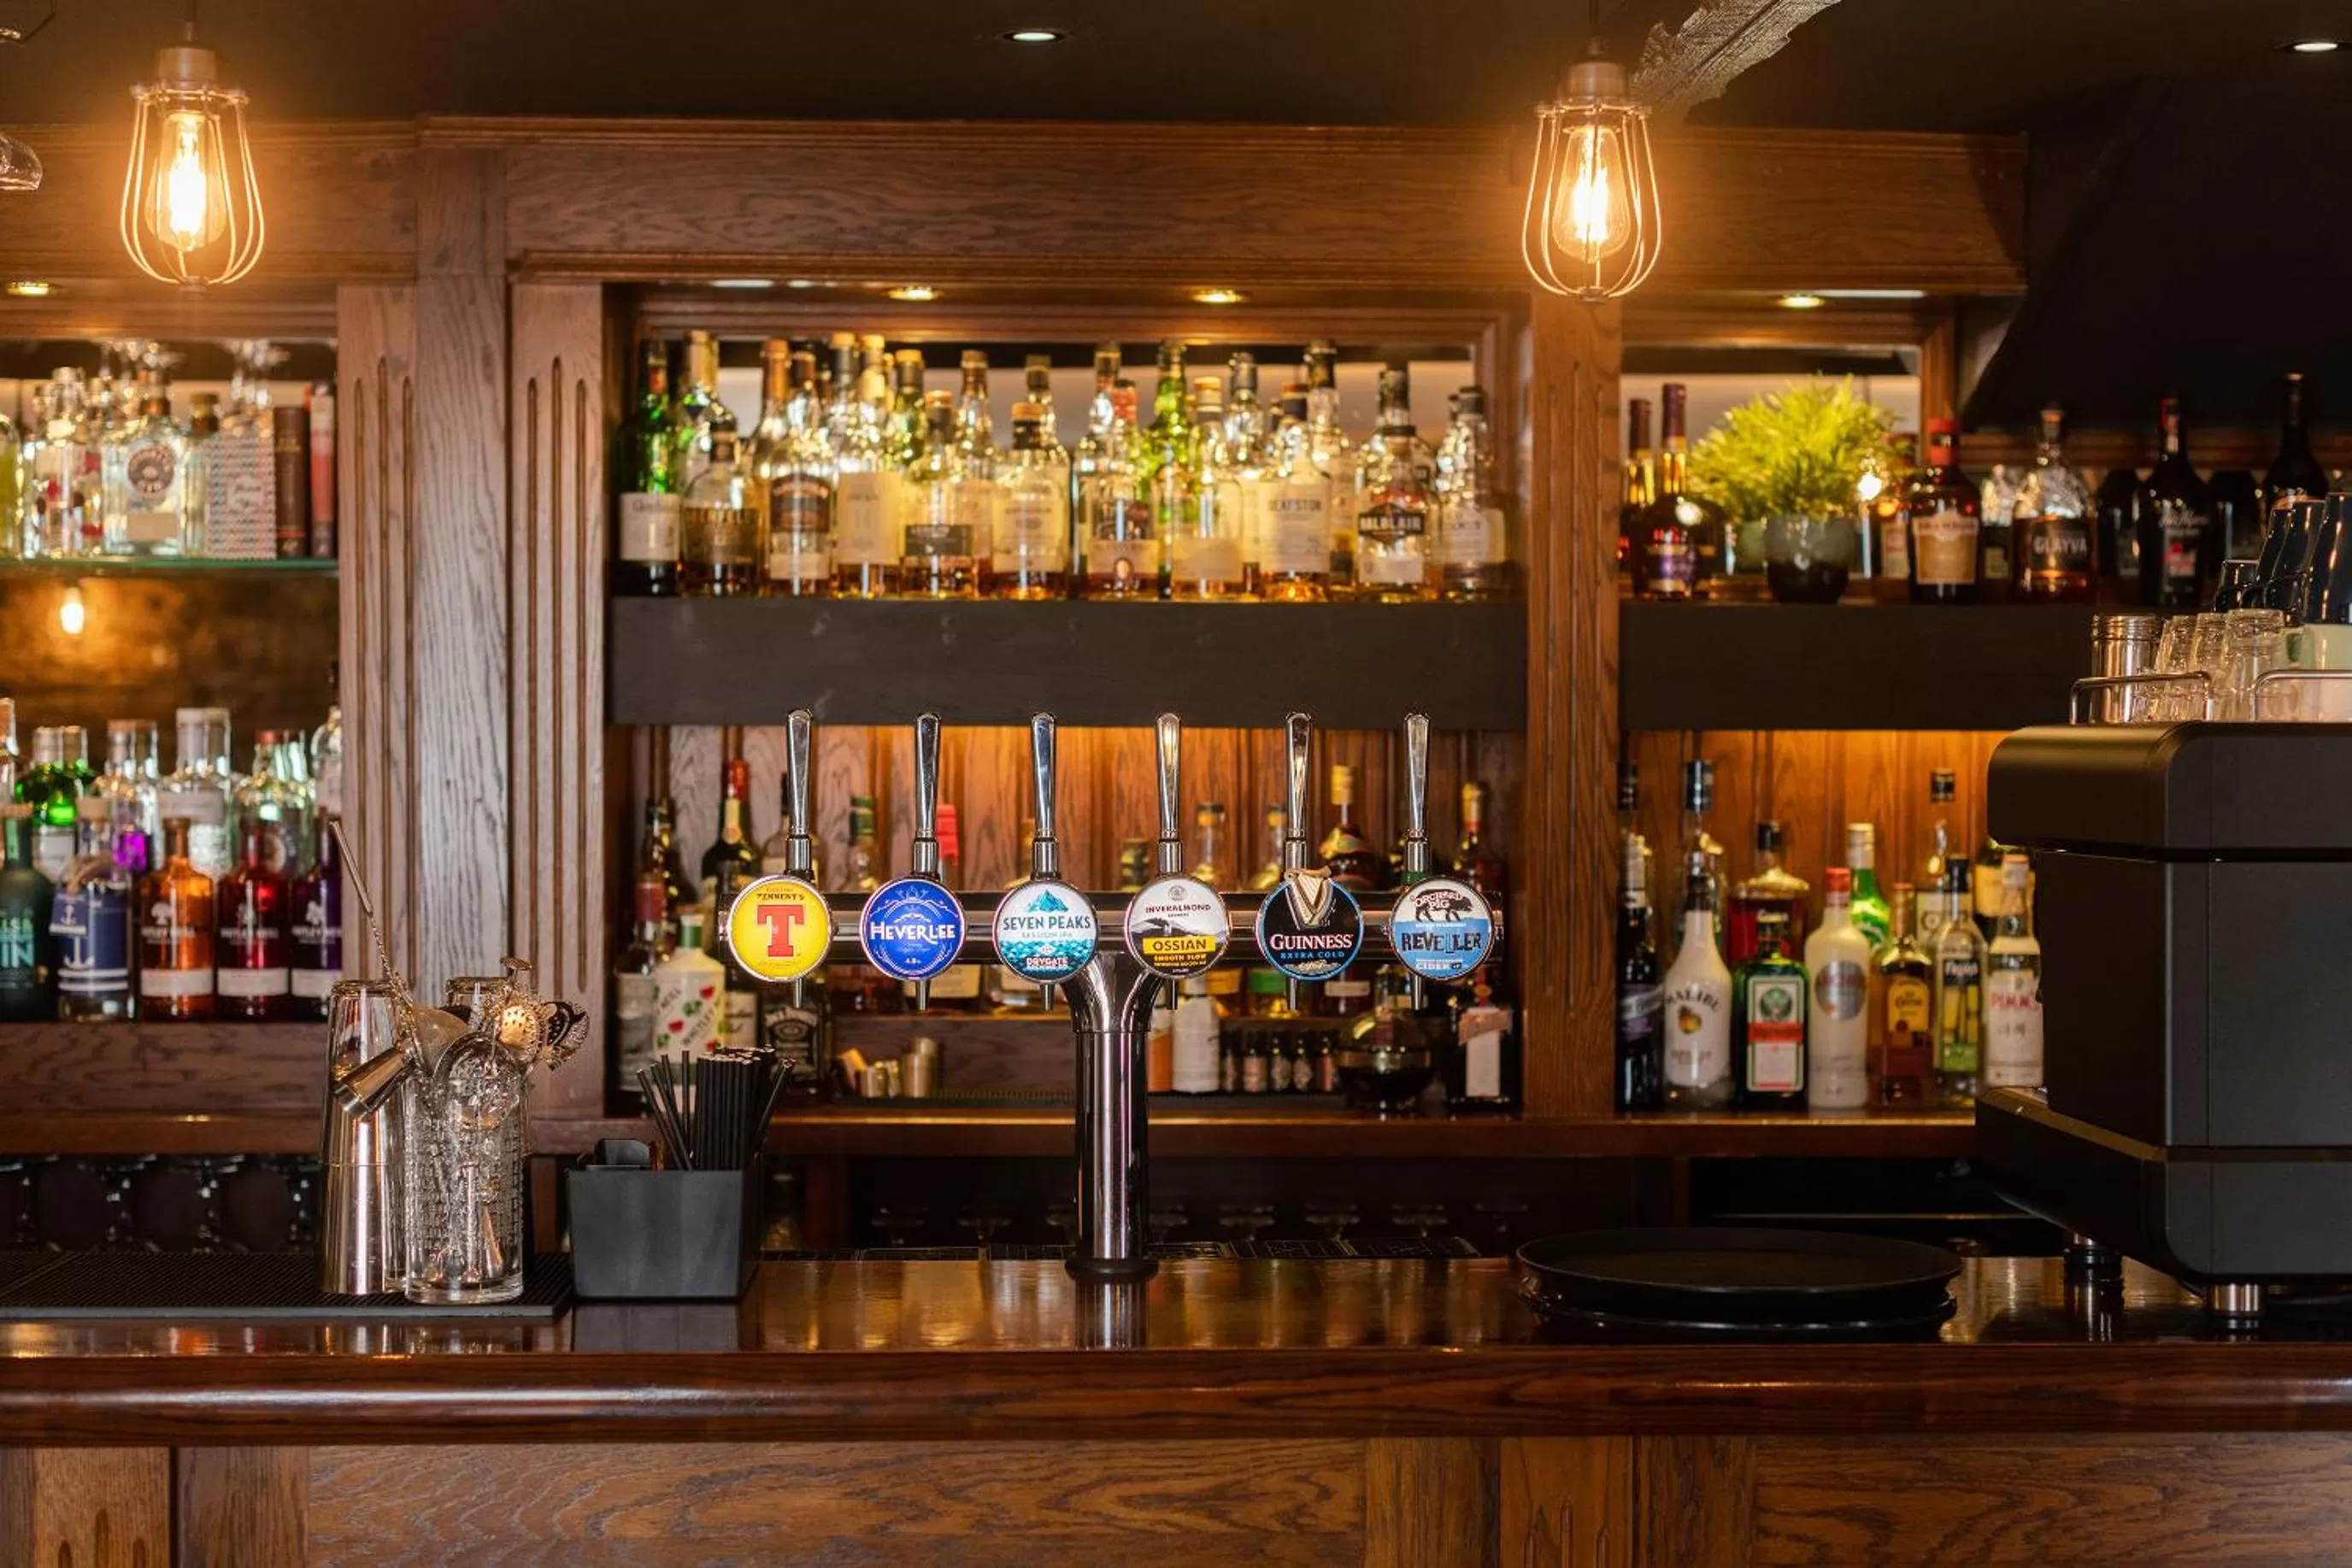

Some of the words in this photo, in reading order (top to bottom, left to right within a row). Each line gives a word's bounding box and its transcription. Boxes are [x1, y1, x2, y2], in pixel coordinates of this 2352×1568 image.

[1145, 904, 1211, 913] INVERALMOND
[1429, 899, 1450, 910] PIG
[757, 904, 804, 957] T
[1003, 916, 1044, 931] SEVEN
[1048, 915, 1091, 930] PEAKS
[870, 921, 956, 945] HEVERLEE
[1152, 938, 1207, 952] OSSIAN
[1270, 933, 1353, 950] GUINNESS
[1402, 931, 1481, 954] REVELLER
[1026, 956, 1069, 967] DRYGATE
